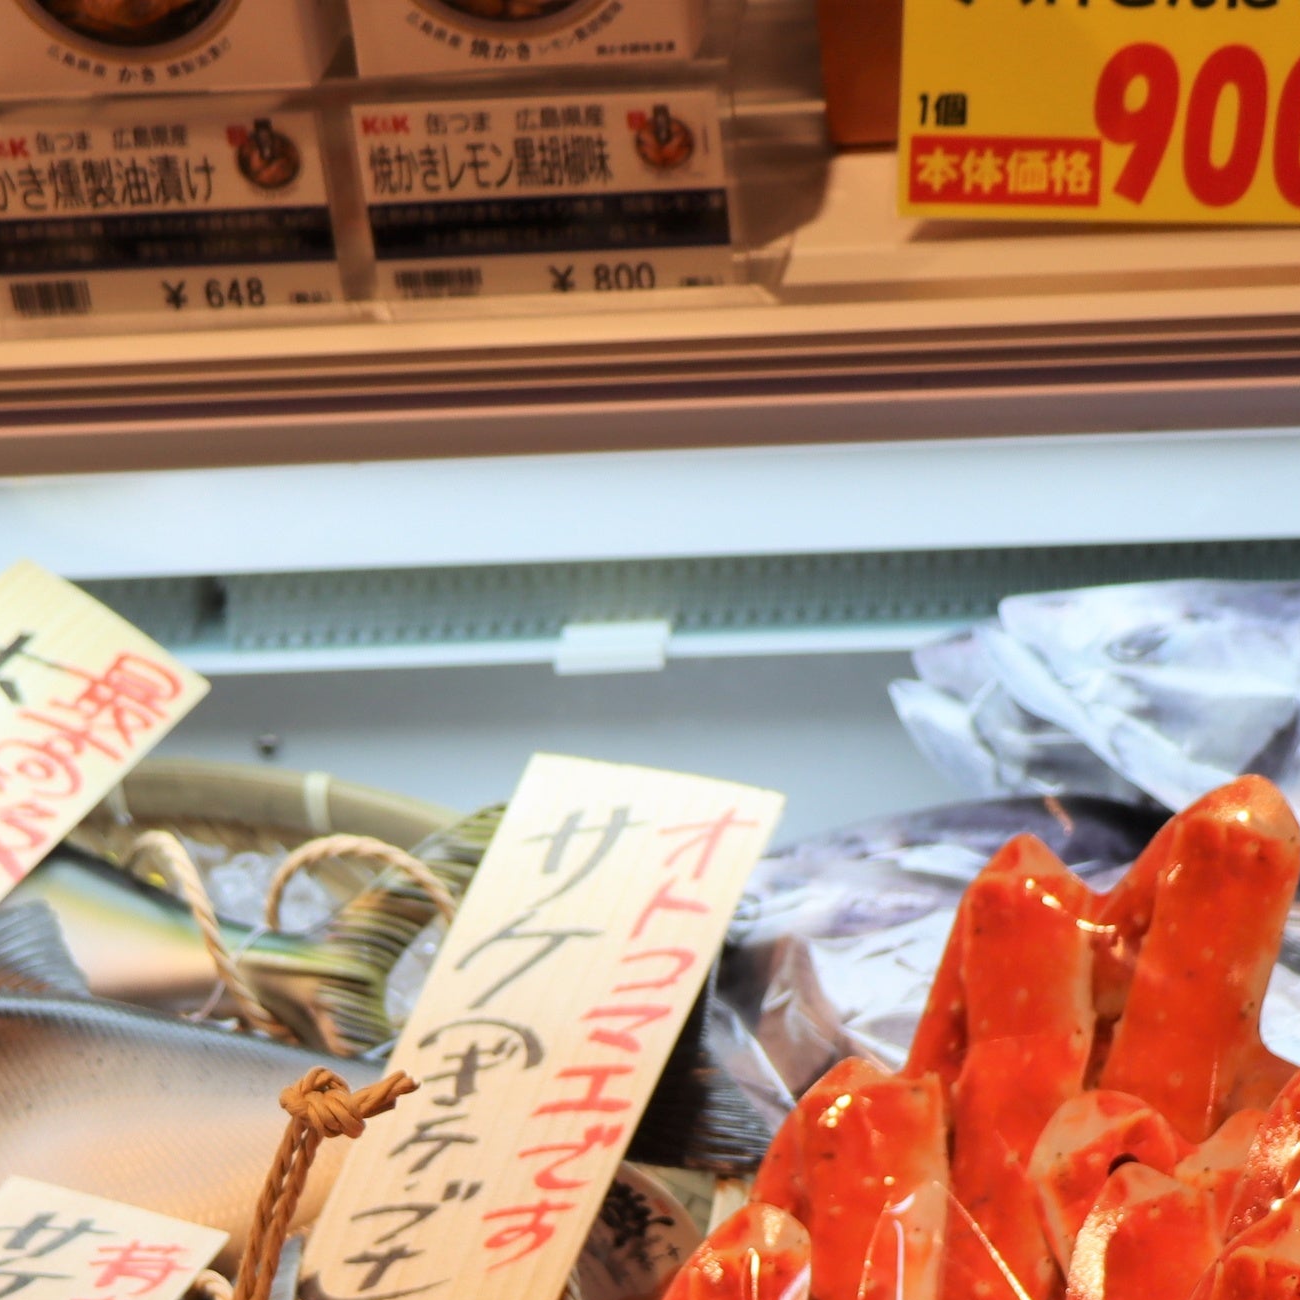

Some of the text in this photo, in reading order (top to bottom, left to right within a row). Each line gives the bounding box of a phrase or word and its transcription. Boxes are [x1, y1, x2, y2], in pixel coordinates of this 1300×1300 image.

[919, 94, 968, 126] 1個
[917, 150, 1092, 195] 本体価格
[204, 277, 265, 307] 648
[594, 262, 655, 290] 800
[482, 807, 758, 1272] オトコマエです
